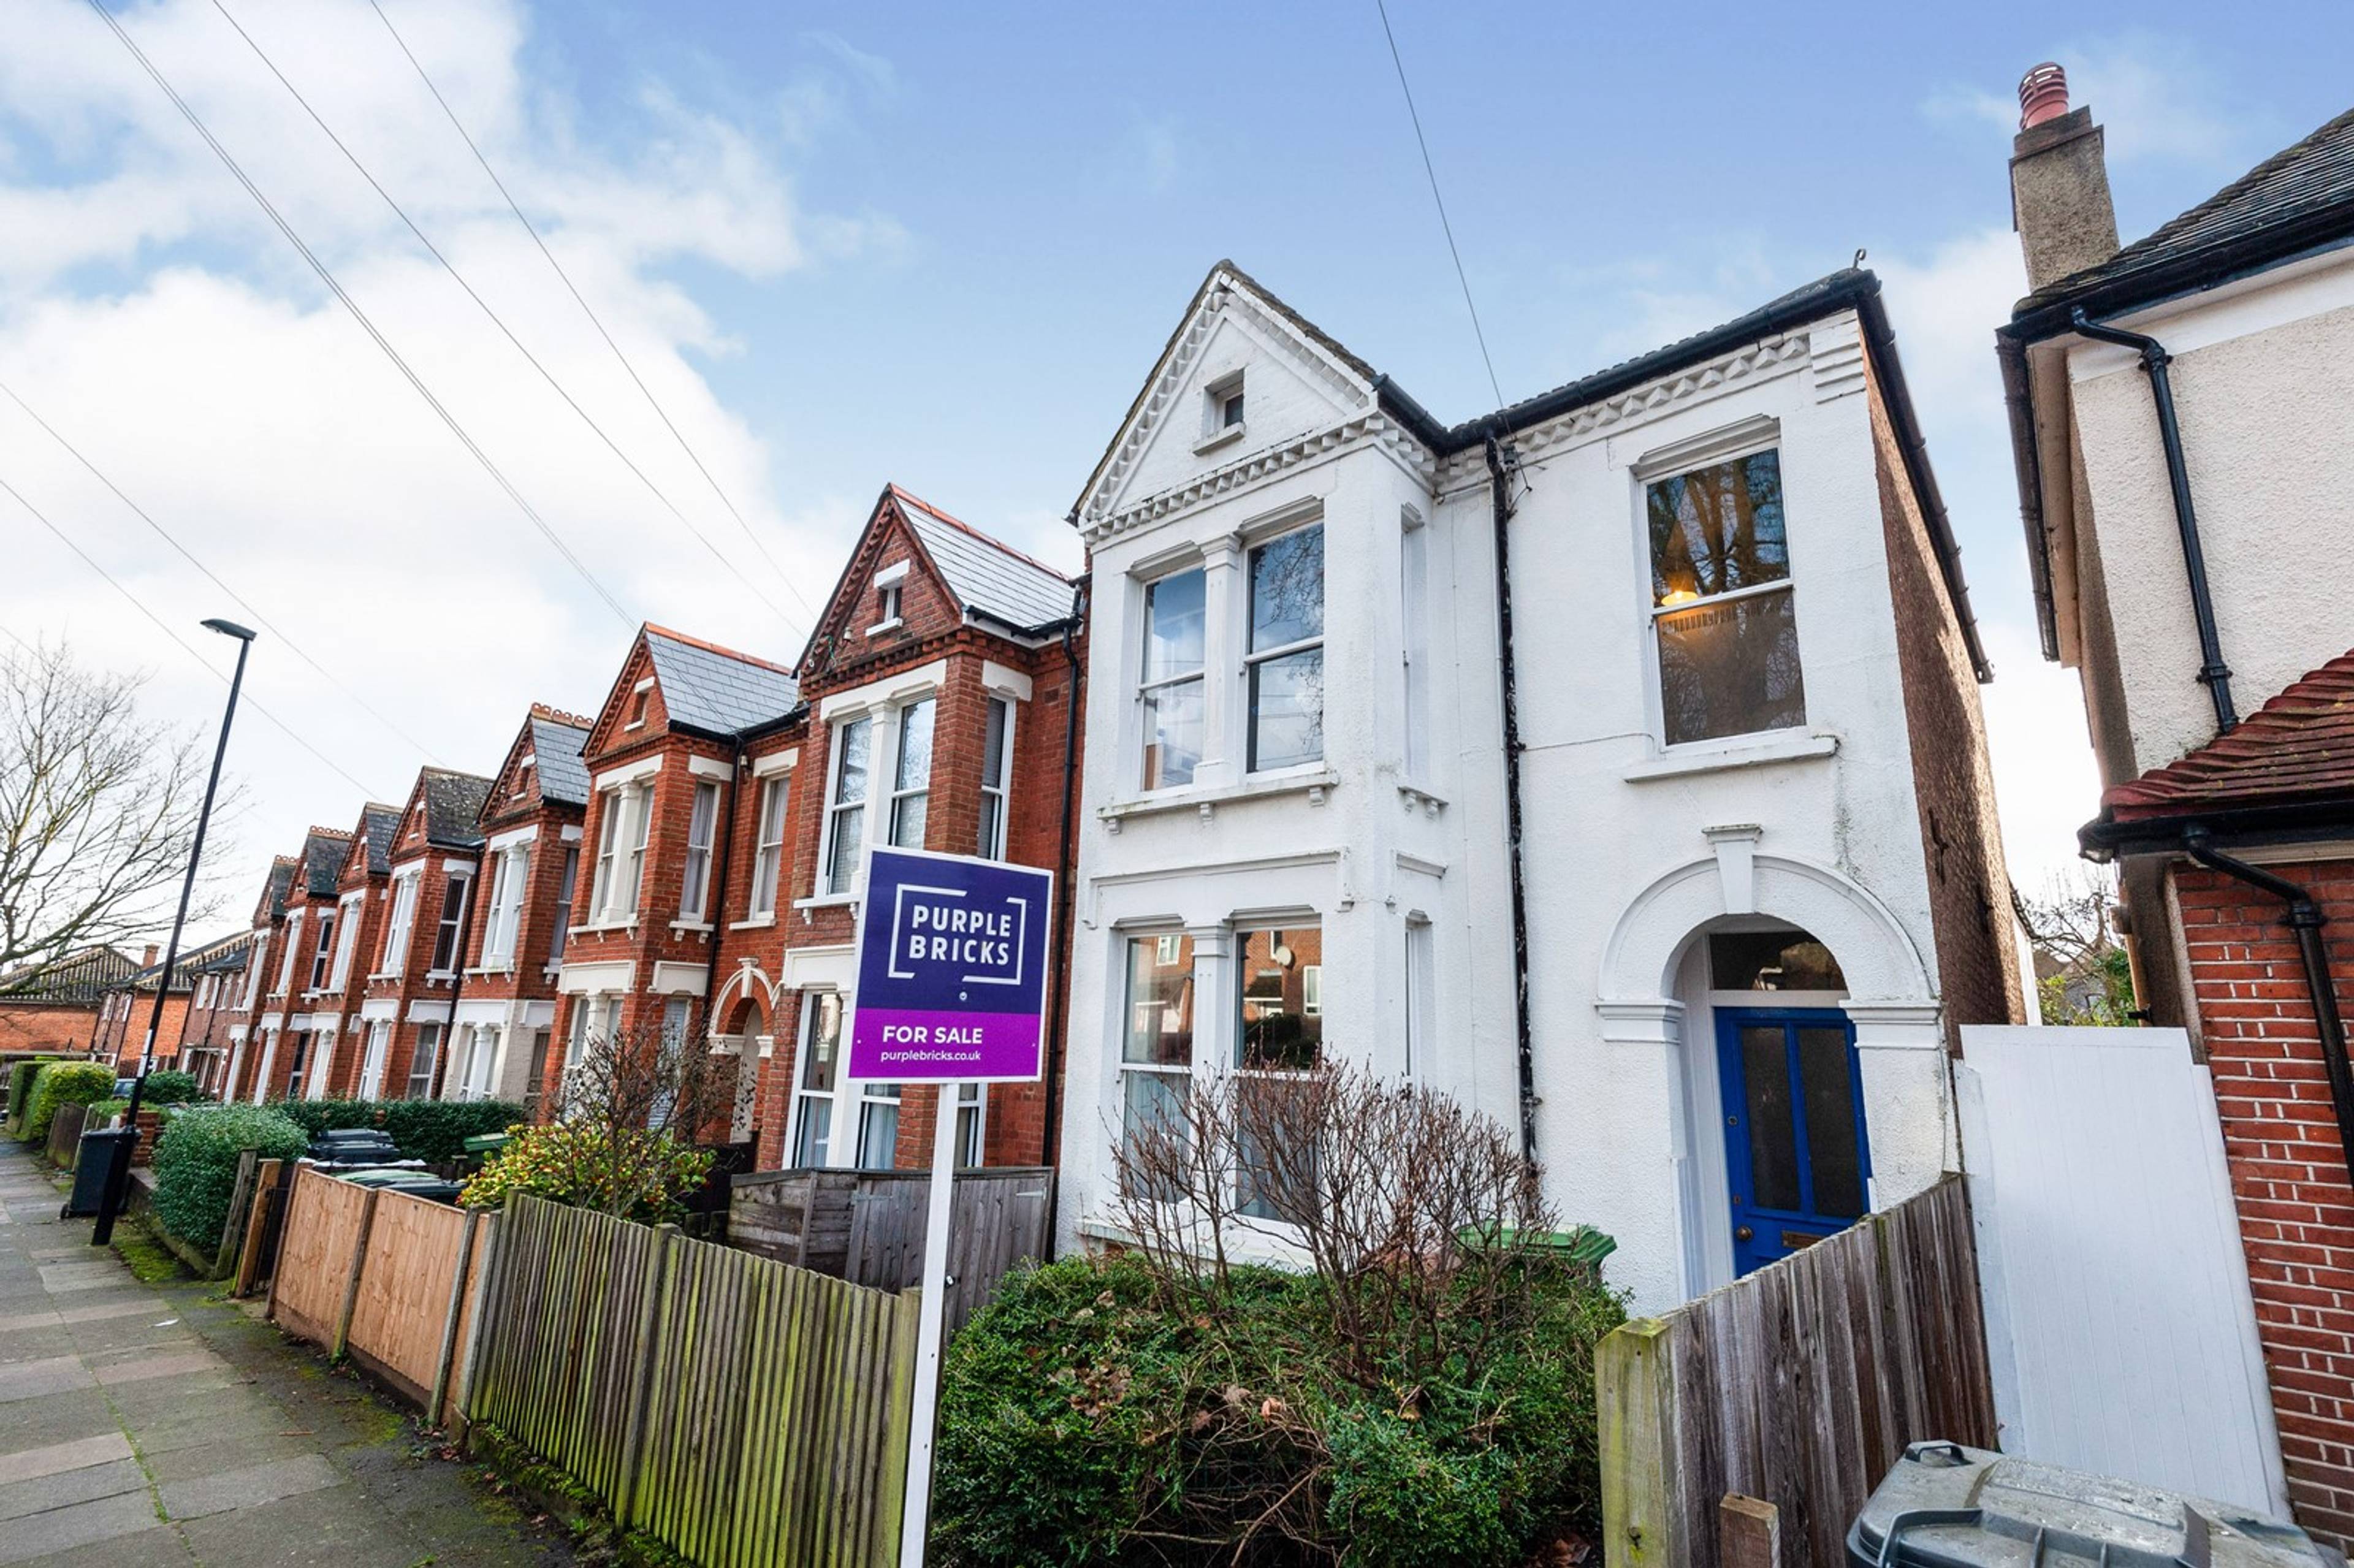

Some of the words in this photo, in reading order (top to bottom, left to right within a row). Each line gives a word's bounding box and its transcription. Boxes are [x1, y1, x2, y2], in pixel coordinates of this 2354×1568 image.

[912, 905, 1011, 937] PURPLE
[908, 935, 1010, 965] BRICKS
[882, 1026, 928, 1043] FOR
[934, 1027, 983, 1044] SALE
[881, 1050, 981, 1062] purplebricks.co.uk
